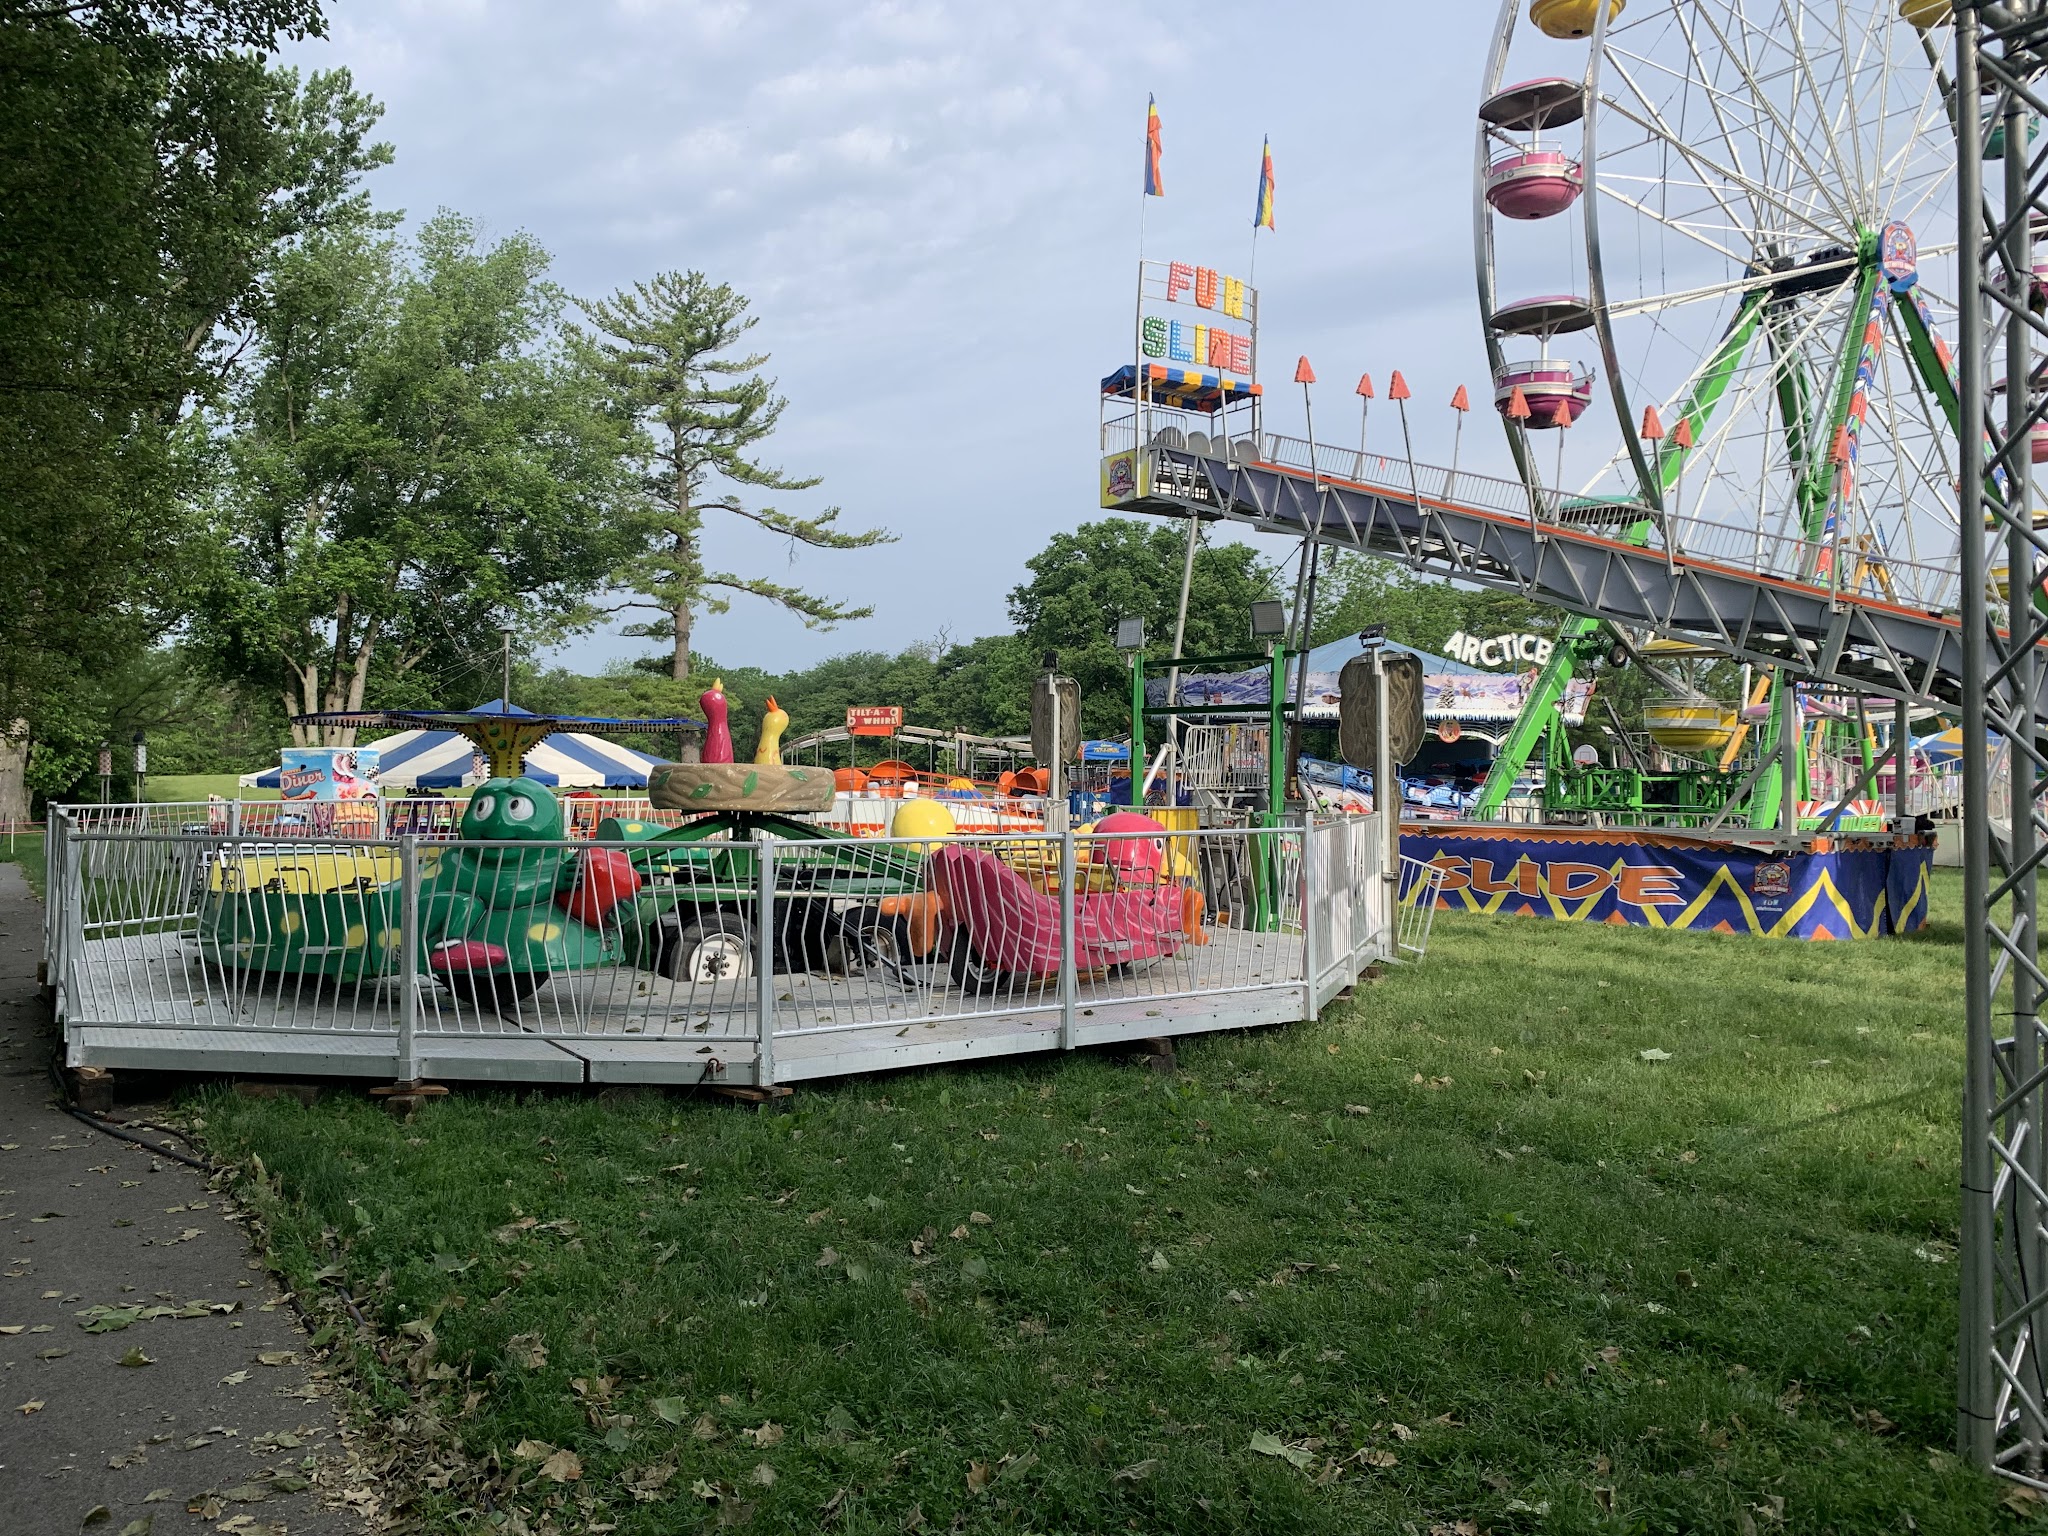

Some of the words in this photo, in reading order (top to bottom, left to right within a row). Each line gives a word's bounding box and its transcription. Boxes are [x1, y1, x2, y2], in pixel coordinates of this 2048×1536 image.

[1167, 260, 1244, 319] FUN
[850, 708, 884, 717] TILT-A-
[863, 717, 897, 725] WHIRL
[281, 771, 327, 791] Diner
[1422, 855, 1688, 905] SLIDE
